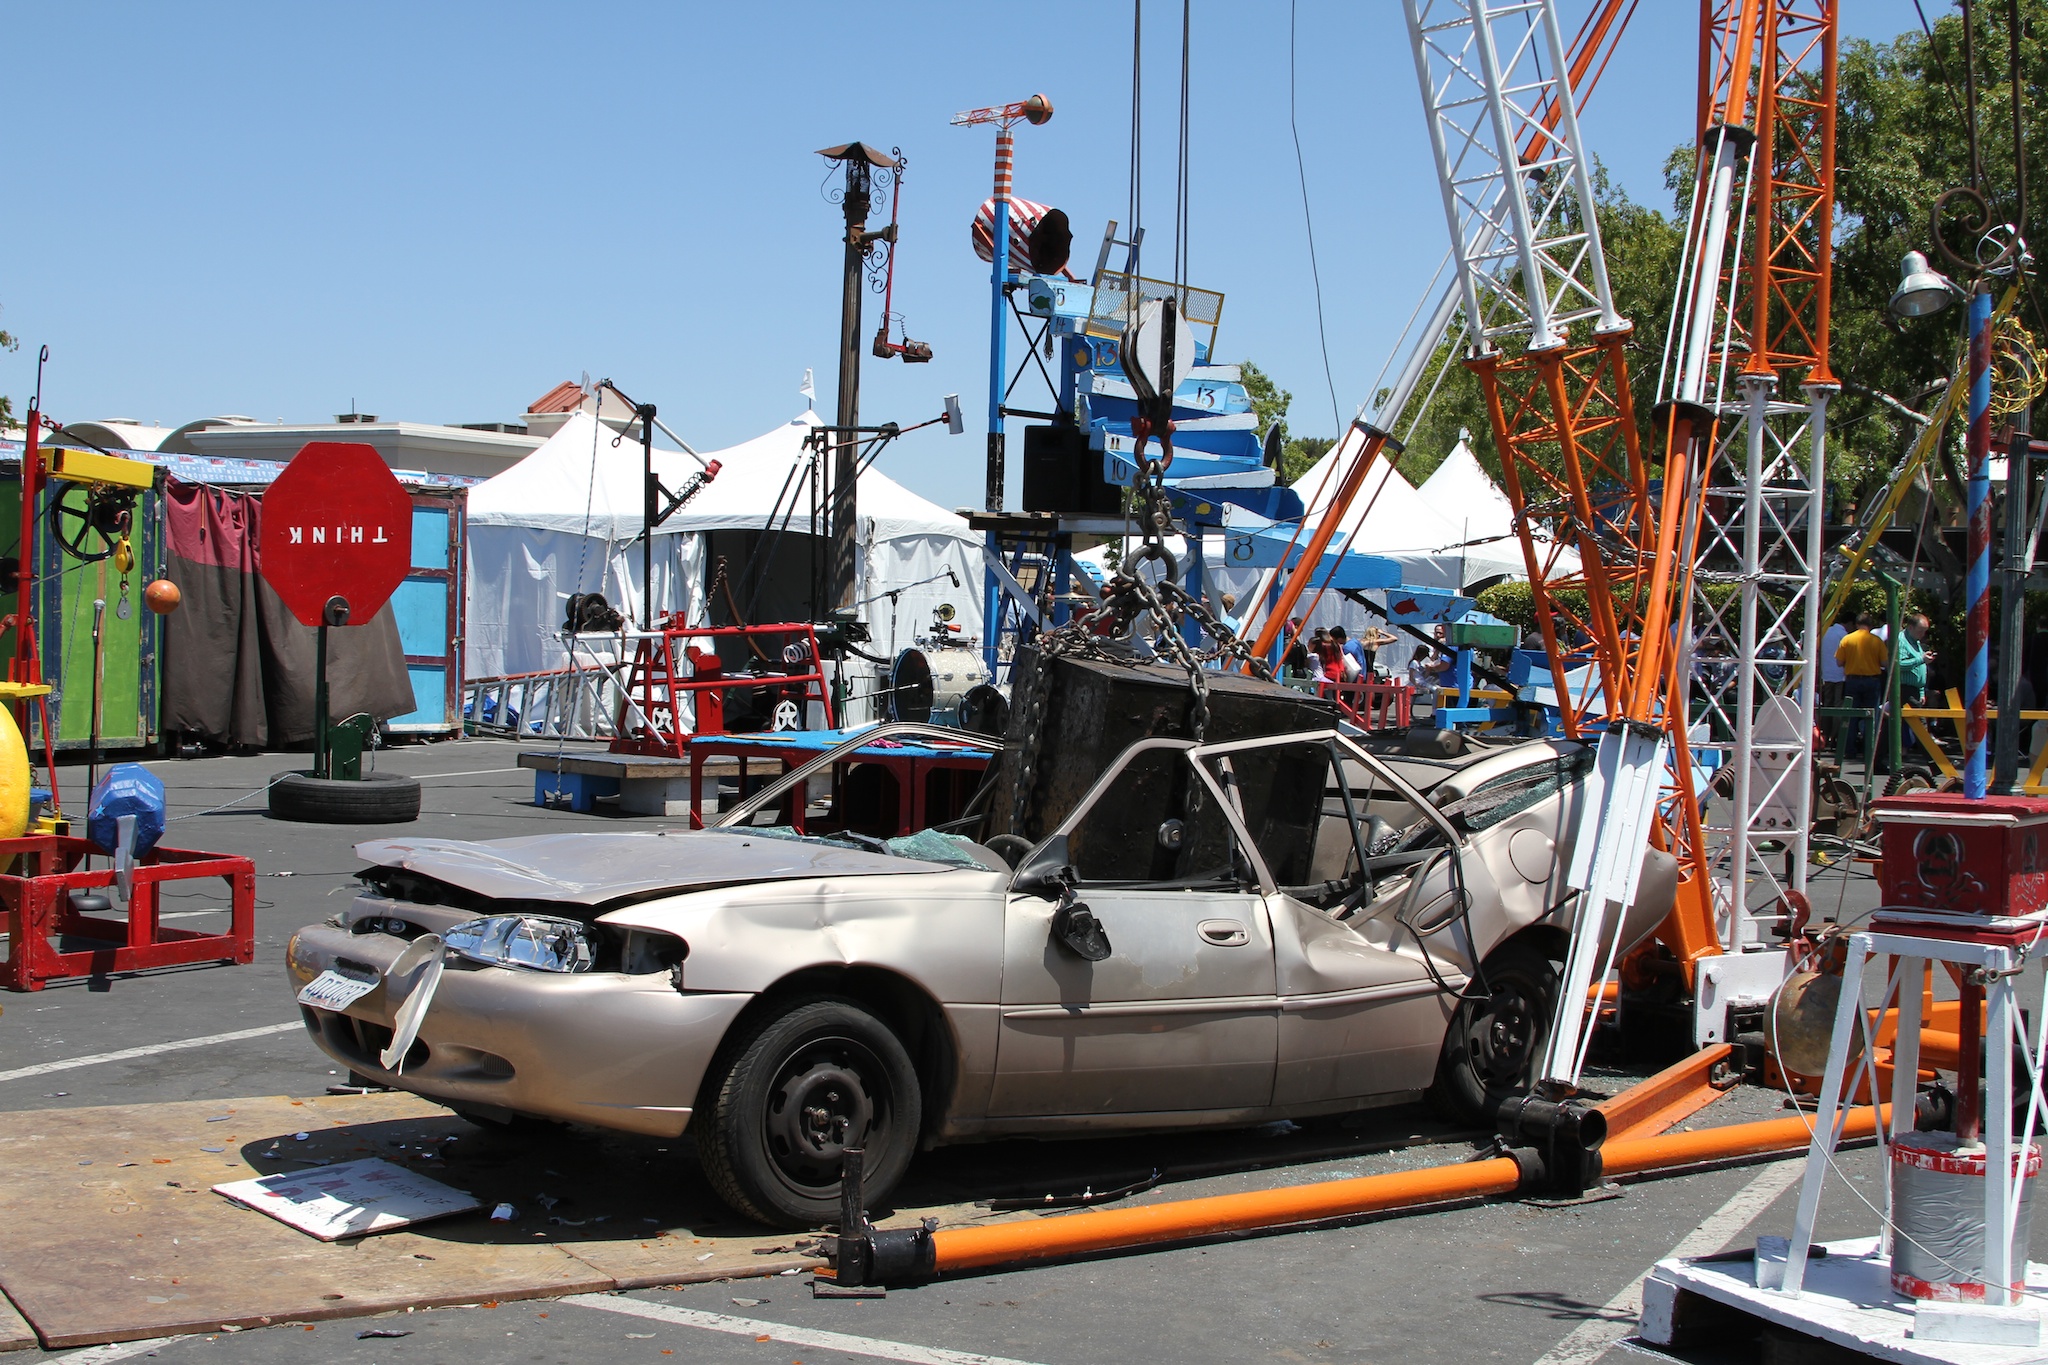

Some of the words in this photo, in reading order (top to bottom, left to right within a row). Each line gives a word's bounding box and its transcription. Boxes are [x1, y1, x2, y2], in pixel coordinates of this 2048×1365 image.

[1095, 341, 1118, 367] 13
[1196, 386, 1216, 409] 13
[1109, 437, 1120, 450] 11
[1111, 458, 1127, 481] 10
[1224, 504, 1232, 523] 9
[289, 526, 388, 544] THINK
[1233, 535, 1254, 561] 8
